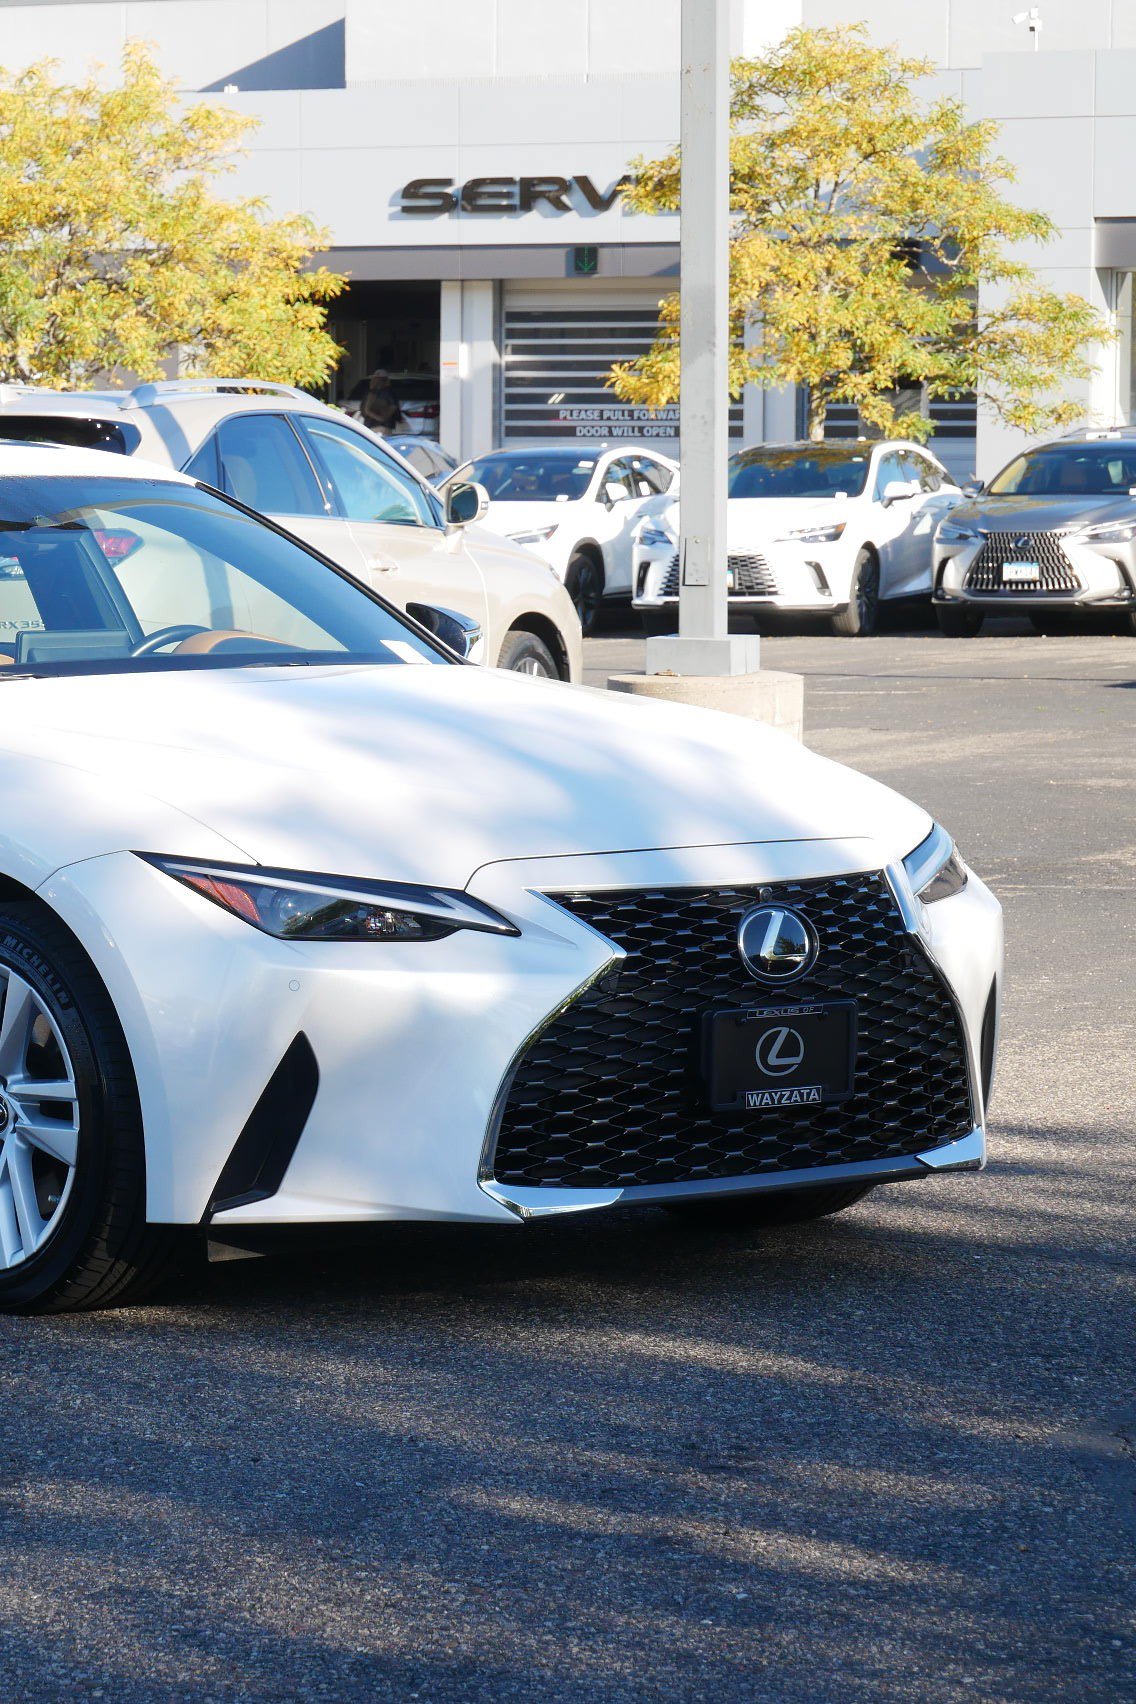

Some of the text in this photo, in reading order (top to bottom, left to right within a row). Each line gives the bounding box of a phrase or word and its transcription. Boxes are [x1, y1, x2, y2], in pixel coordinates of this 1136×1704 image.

[401, 174, 632, 214] SERV
[559, 410, 680, 420] PLEASE PULL FOWA
[576, 426, 675, 436] DOOR WILL OPEN
[20, 620, 43, 629] 35
[4, 935, 70, 1005] MICHELIN
[756, 1007, 800, 1017] LEXUS
[748, 1088, 820, 1107] WAYZATA
